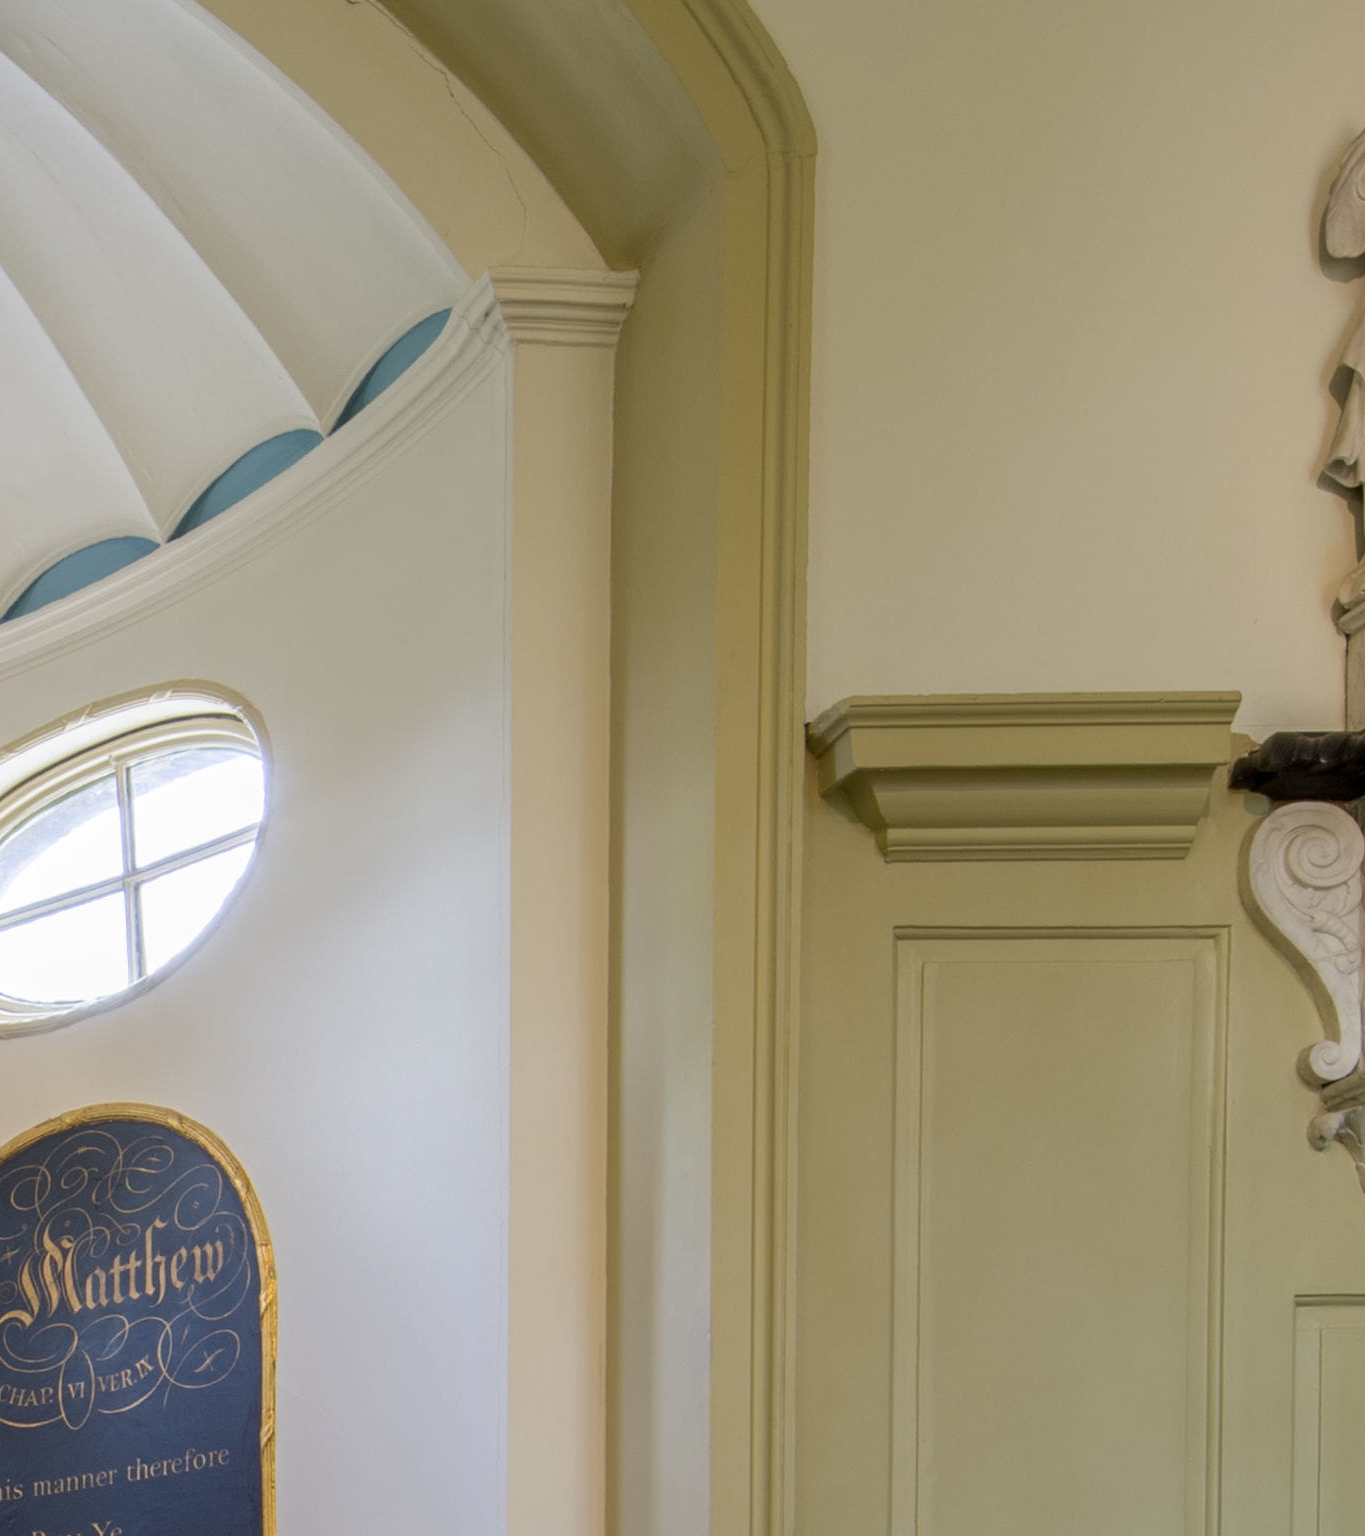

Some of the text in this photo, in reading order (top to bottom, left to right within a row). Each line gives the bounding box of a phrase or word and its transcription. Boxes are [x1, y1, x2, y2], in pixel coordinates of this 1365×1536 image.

[69, 1382, 86, 1399] VI
[95, 1370, 138, 1393] VER.
[137, 1355, 154, 1377] IX
[33, 1469, 117, 1496] manner
[127, 1448, 229, 1482] therefore
